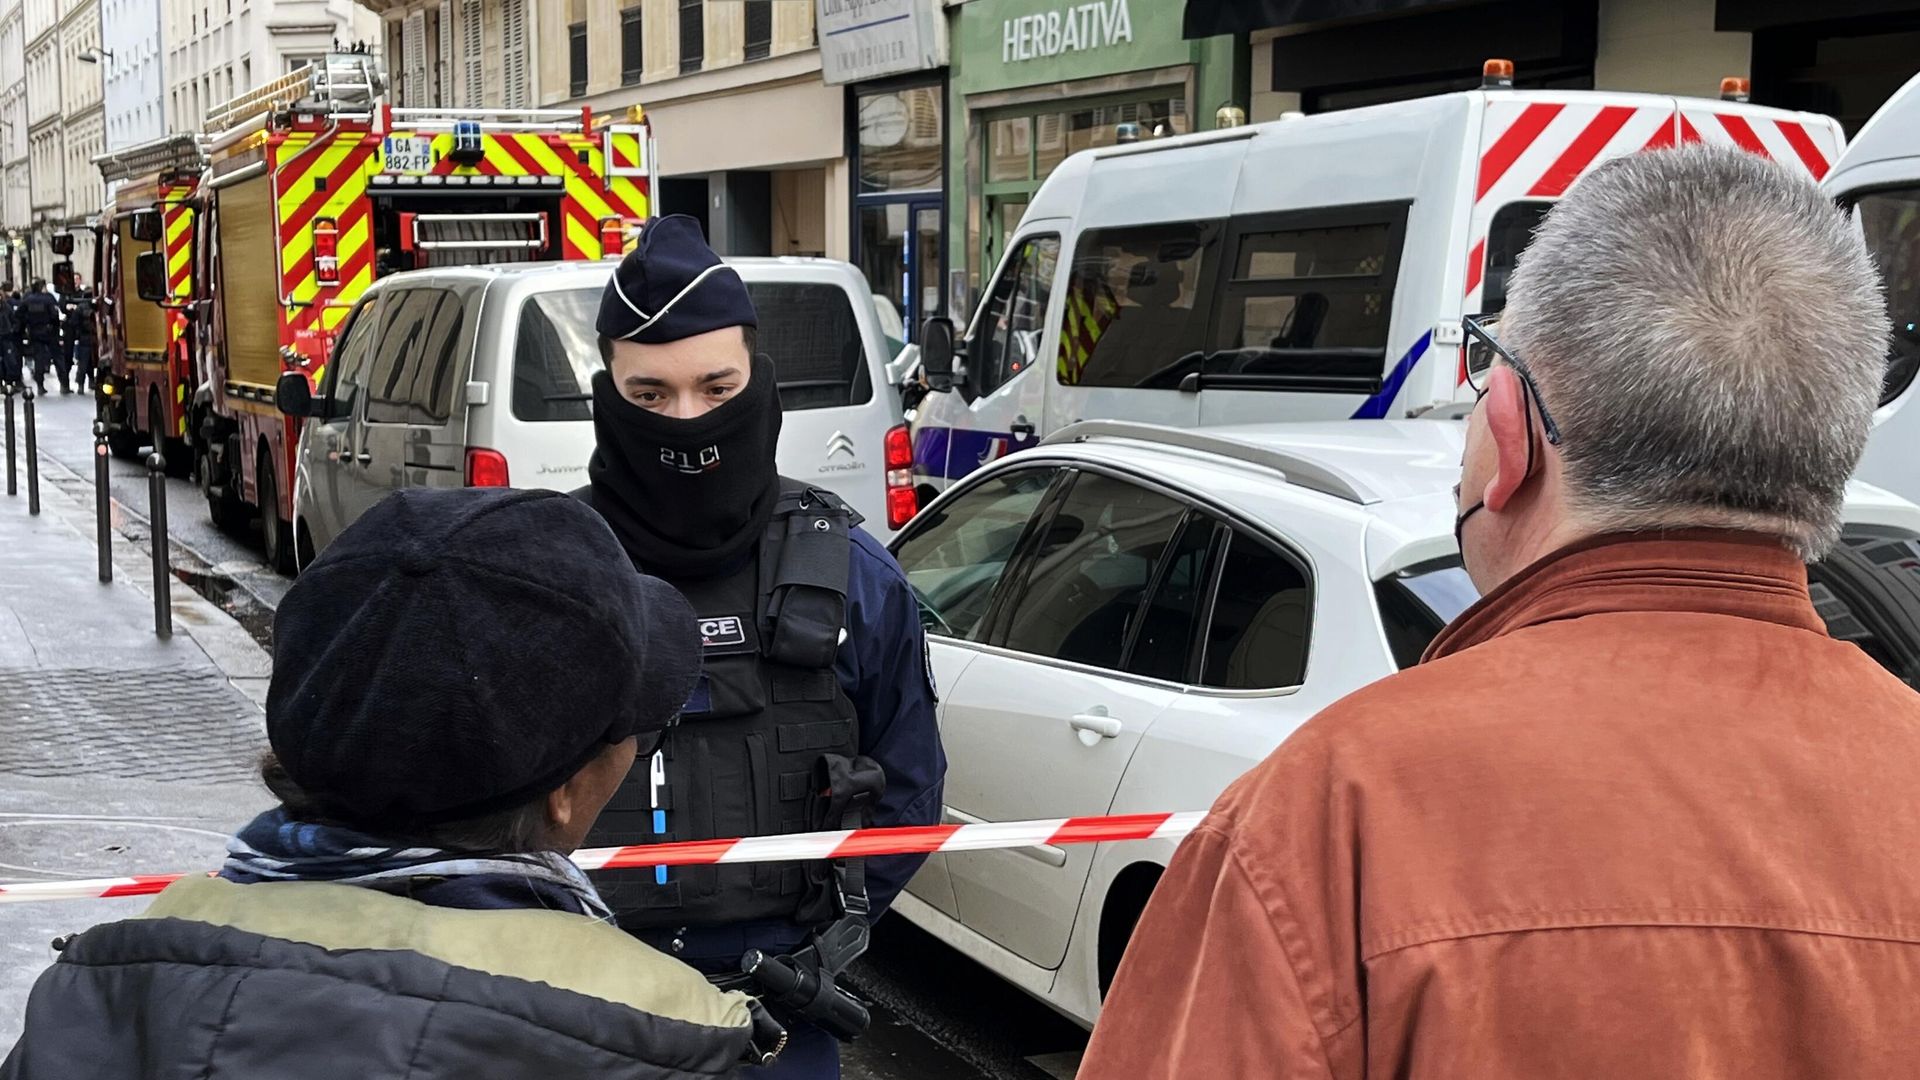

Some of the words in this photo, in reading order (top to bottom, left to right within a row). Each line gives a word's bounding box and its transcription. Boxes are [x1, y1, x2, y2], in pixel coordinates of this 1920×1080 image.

[1002, 0, 1133, 62] HERBATIVA
[835, 40, 906, 72] IMMOBILIER
[660, 447, 695, 469] 21
